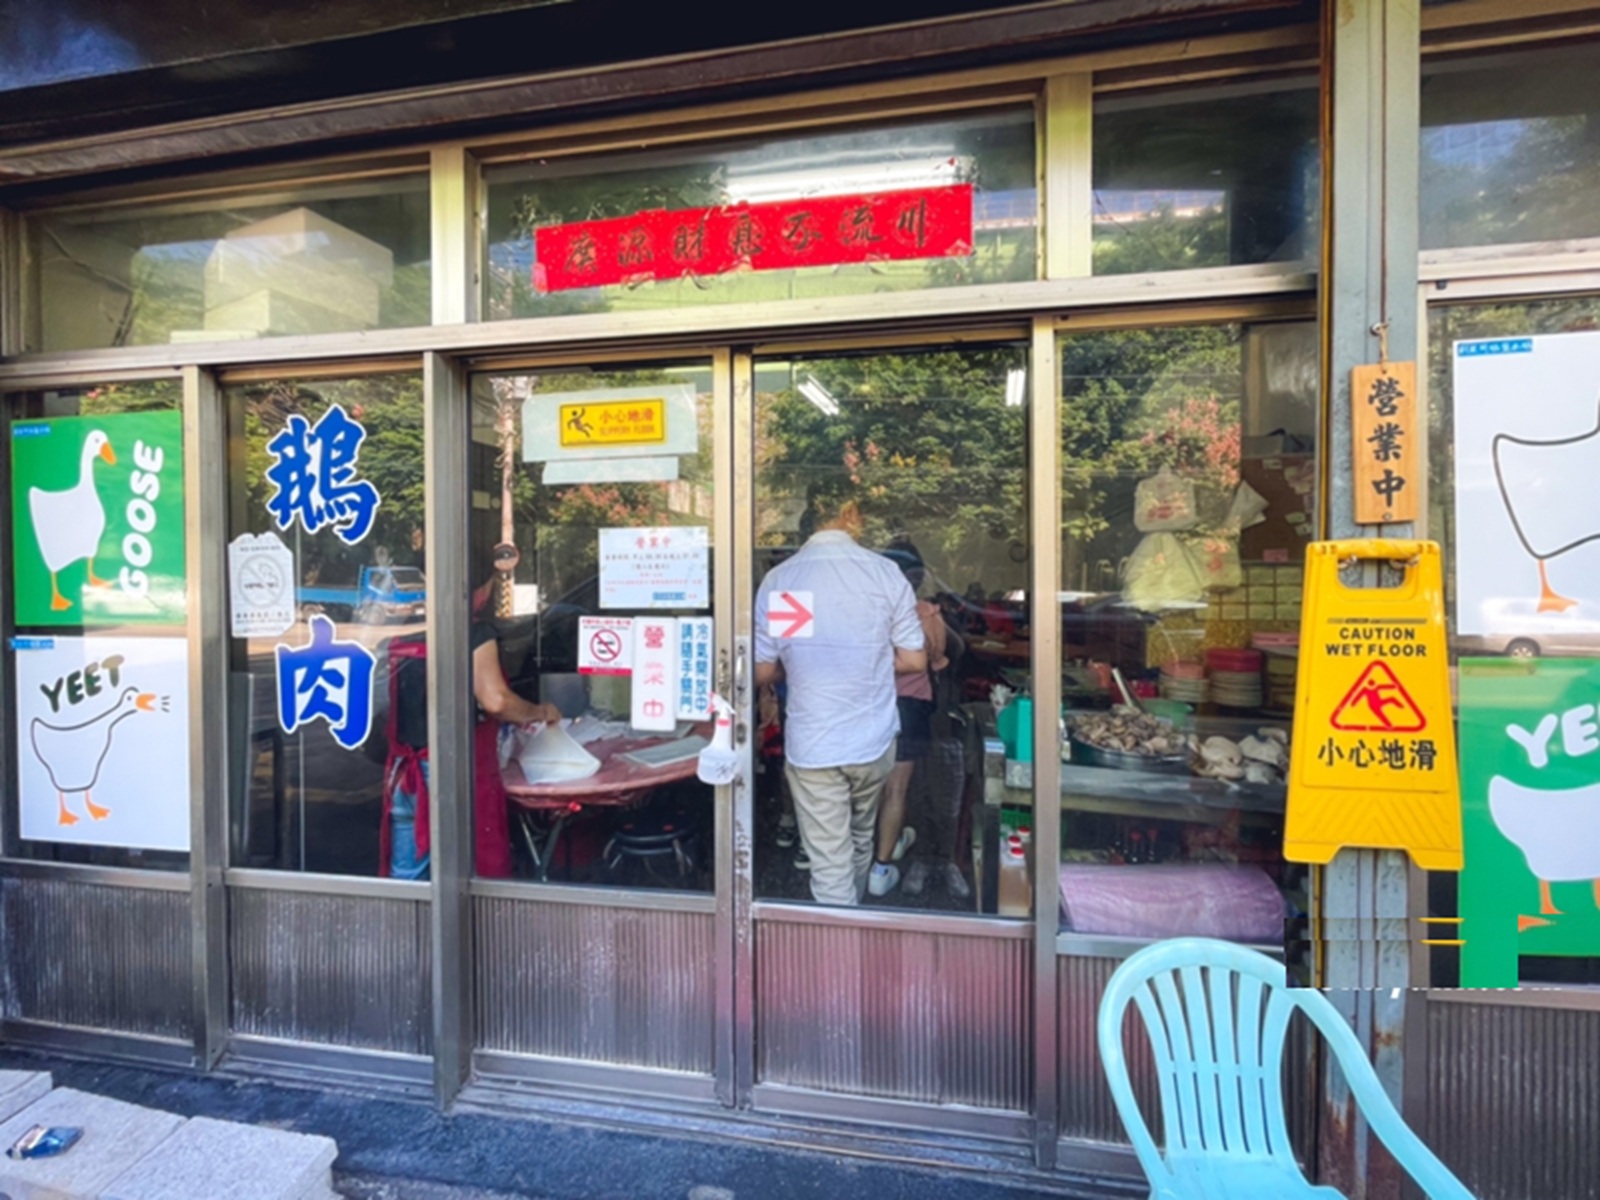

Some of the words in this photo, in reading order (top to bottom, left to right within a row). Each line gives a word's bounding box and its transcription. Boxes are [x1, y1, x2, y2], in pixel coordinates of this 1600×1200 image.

[598, 408, 654, 425] 小心地滑
[1367, 377, 1405, 508] 營業中
[119, 440, 164, 597] GOOSE
[267, 404, 380, 749] 鵝肉
[1325, 643, 1364, 657] WET
[1369, 644, 1427, 657] FLOOR
[1339, 627, 1416, 640] CAUTION
[40, 655, 125, 713] YEET
[1318, 738, 1438, 770] 小心地滑
[1505, 703, 1600, 769] YE
